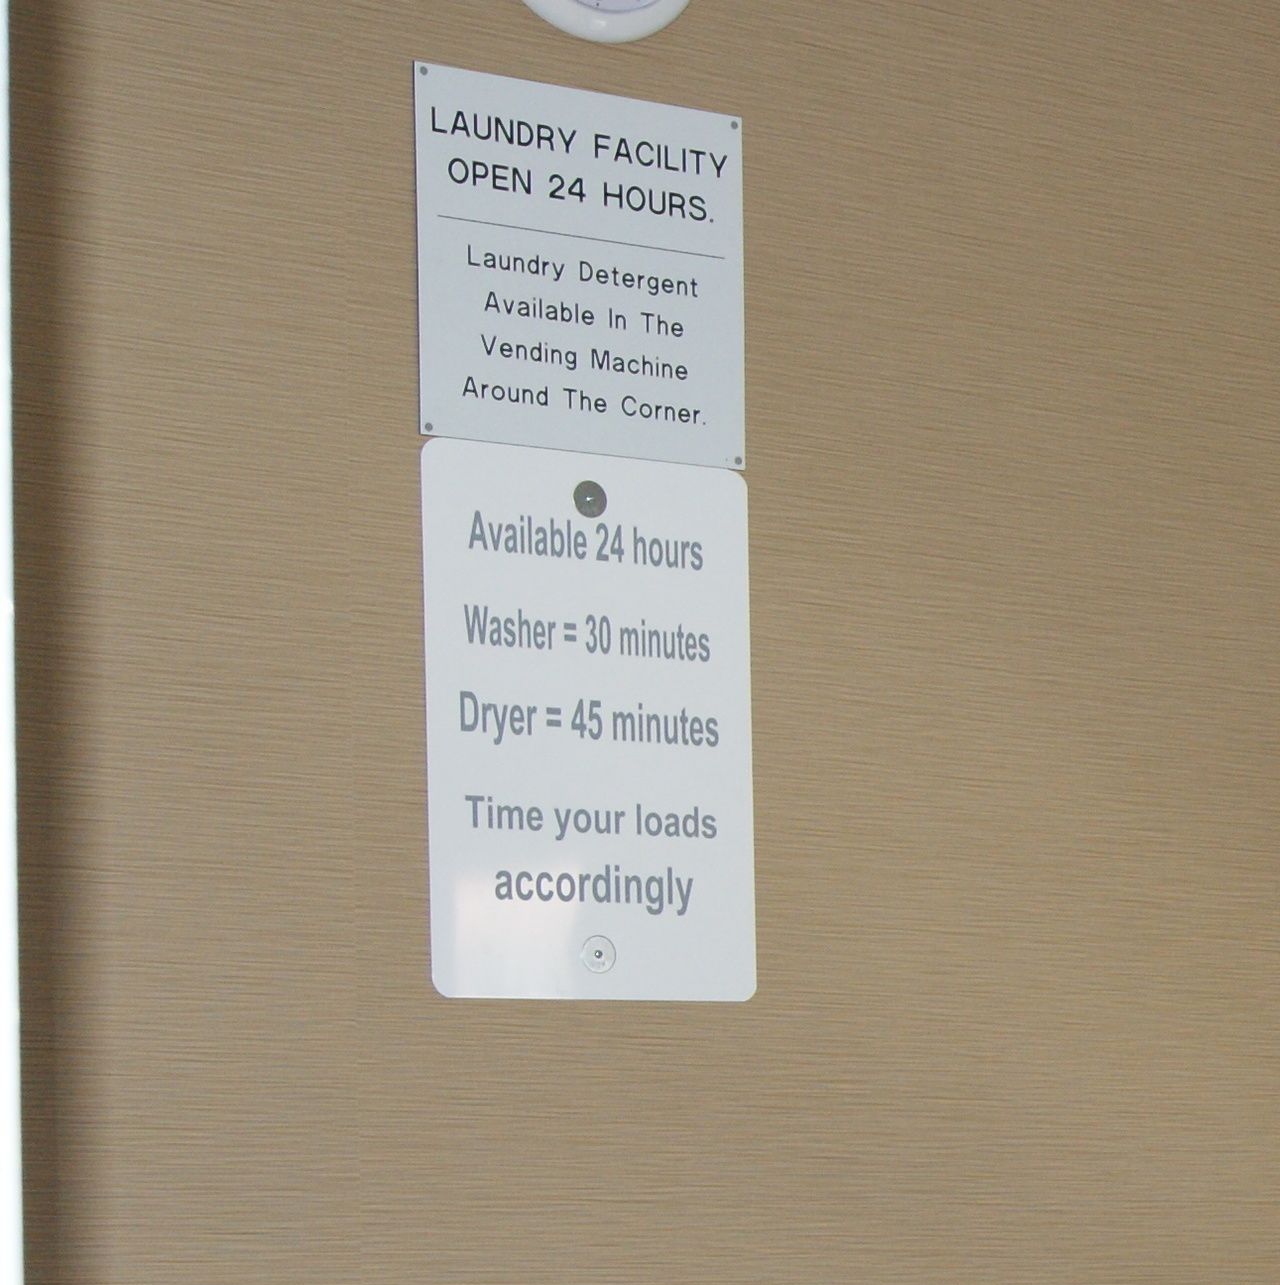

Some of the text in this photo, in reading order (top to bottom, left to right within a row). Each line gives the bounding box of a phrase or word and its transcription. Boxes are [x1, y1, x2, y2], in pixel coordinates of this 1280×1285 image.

[430, 105, 728, 179] LAUNDRY FACILITY
[447, 157, 715, 224] OPEN 24 HOURS.
[467, 243, 699, 299] Laundry Detergent
[484, 290, 684, 338] Available In The
[480, 333, 689, 381] Vending Machine
[461, 375, 706, 426] Around The Corner.
[468, 509, 704, 572] Available 24 hours
[463, 603, 711, 663] Washer = 30 minutes
[459, 690, 720, 748] Dryer = 45 minutes
[464, 794, 718, 842] Time your loads
[494, 863, 694, 917] accordingly
